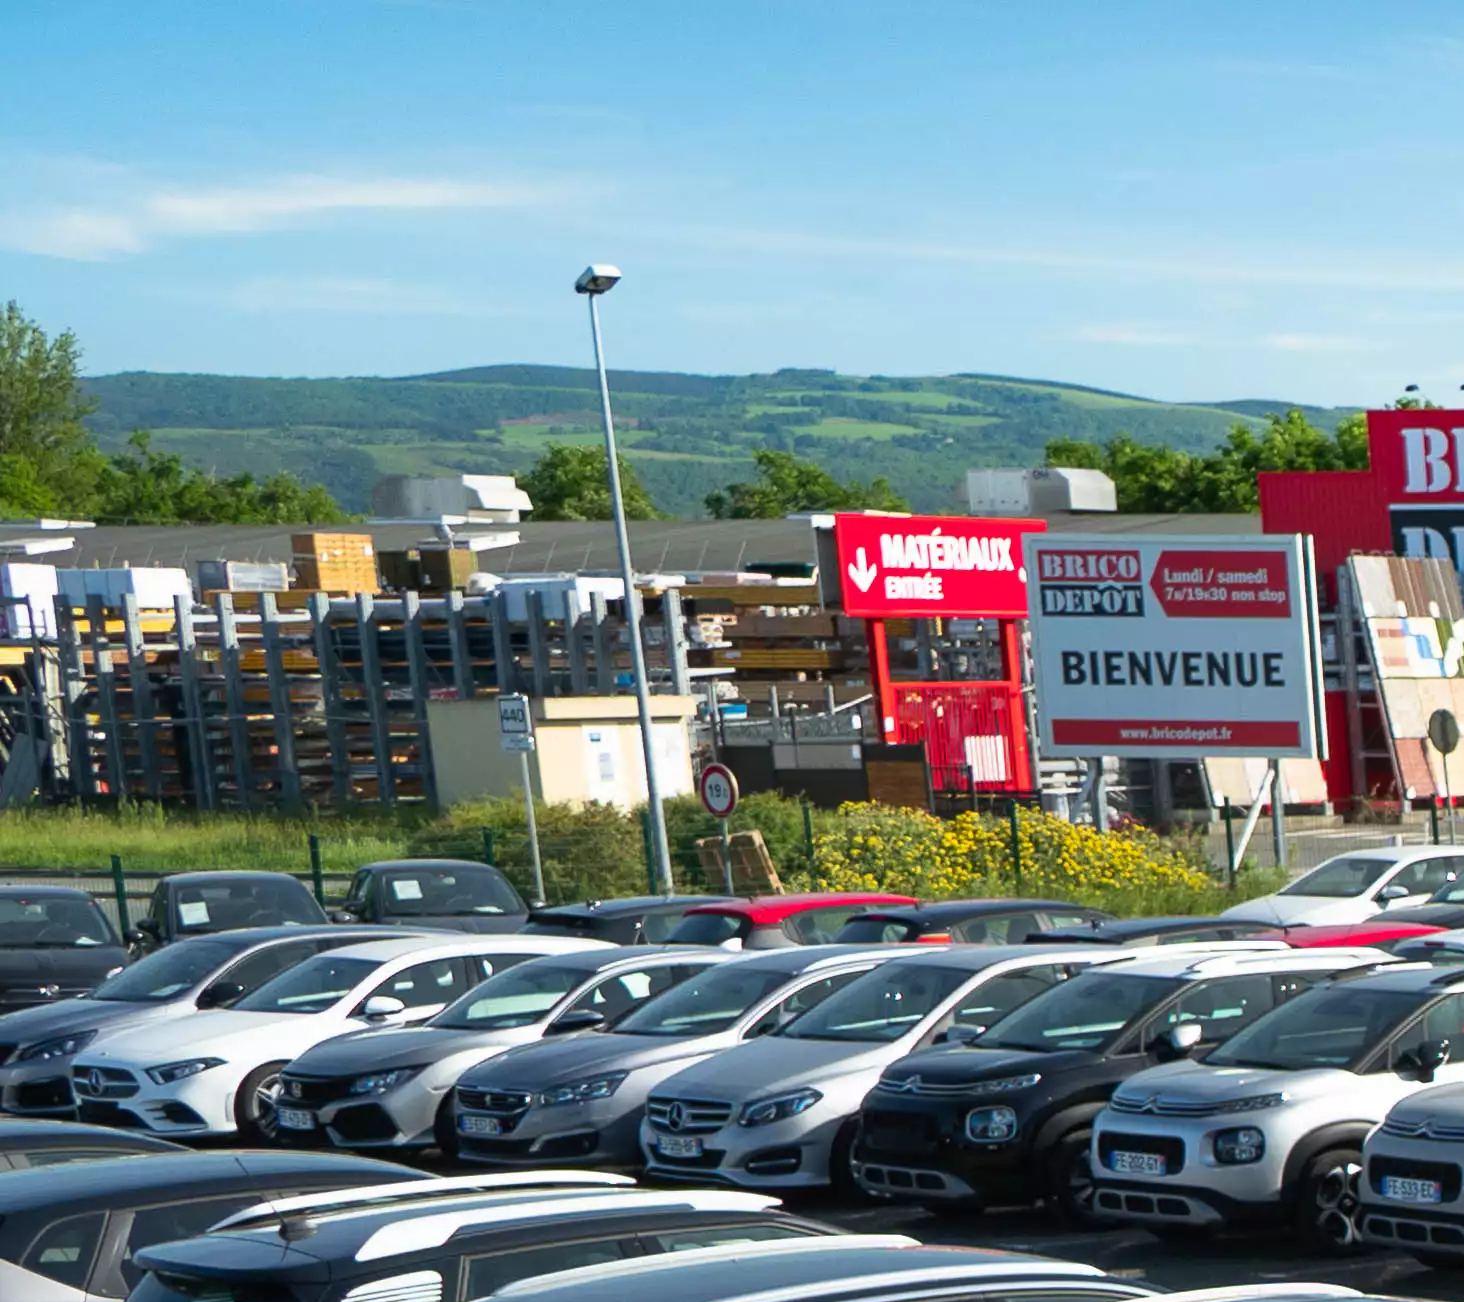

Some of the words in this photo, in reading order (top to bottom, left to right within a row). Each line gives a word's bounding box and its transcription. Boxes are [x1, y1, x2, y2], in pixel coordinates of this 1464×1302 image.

[880, 527, 1015, 571] MATÉRIAUX
[1041, 554, 1138, 579] BRICO
[1164, 569, 1204, 584] Lundi
[1217, 568, 1268, 584] samedi
[1061, 650, 1285, 687] BIENVENUE
[1120, 727, 1232, 741] www.bricodepot.fr
